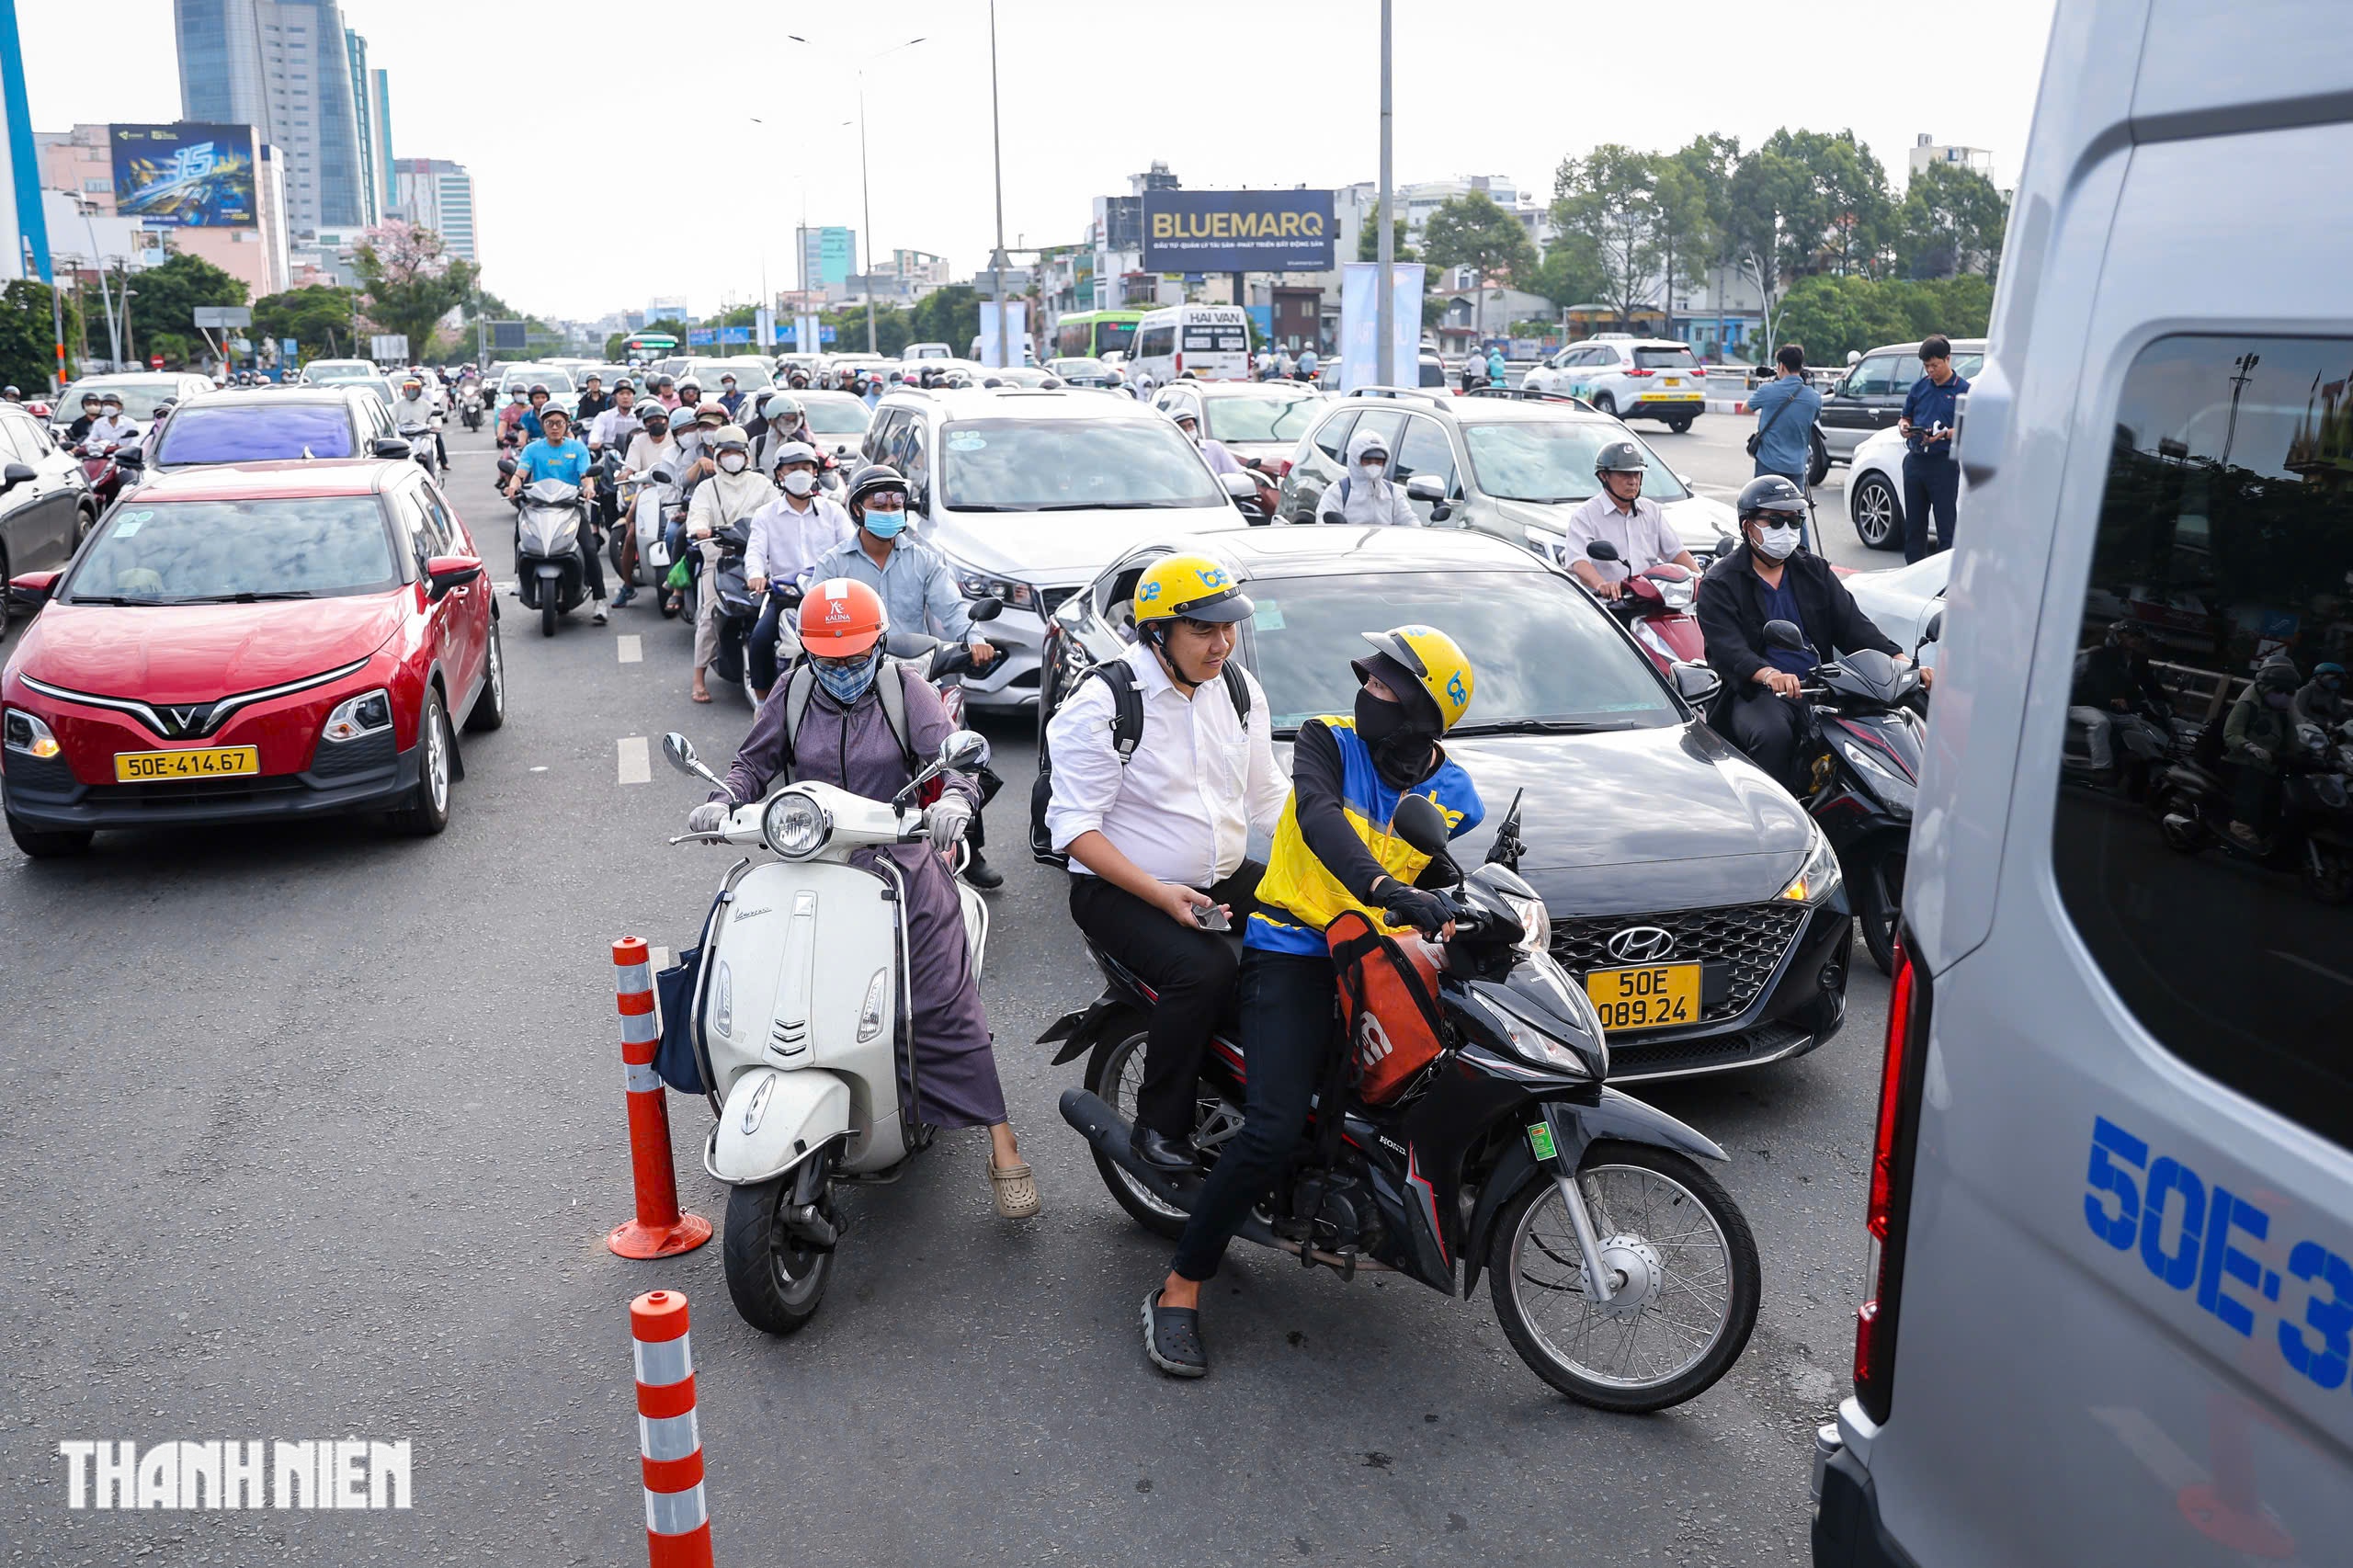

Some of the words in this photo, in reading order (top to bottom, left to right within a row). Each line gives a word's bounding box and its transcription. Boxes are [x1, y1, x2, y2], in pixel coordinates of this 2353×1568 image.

[174, 141, 214, 181] 15
[1153, 212, 1324, 239] BLUEMARQ
[1189, 312, 1211, 324] HAI
[1214, 312, 1240, 324] VAN
[1195, 568, 1229, 588] be
[824, 614, 851, 622] KALINA
[1446, 669, 1468, 707] be
[129, 753, 244, 776] 50E-414.67
[1620, 969, 1668, 998] 50E
[1597, 995, 1688, 1028] 089.24
[1379, 1135, 1407, 1156] HOND
[2084, 1115, 2353, 1391] 50E-3
